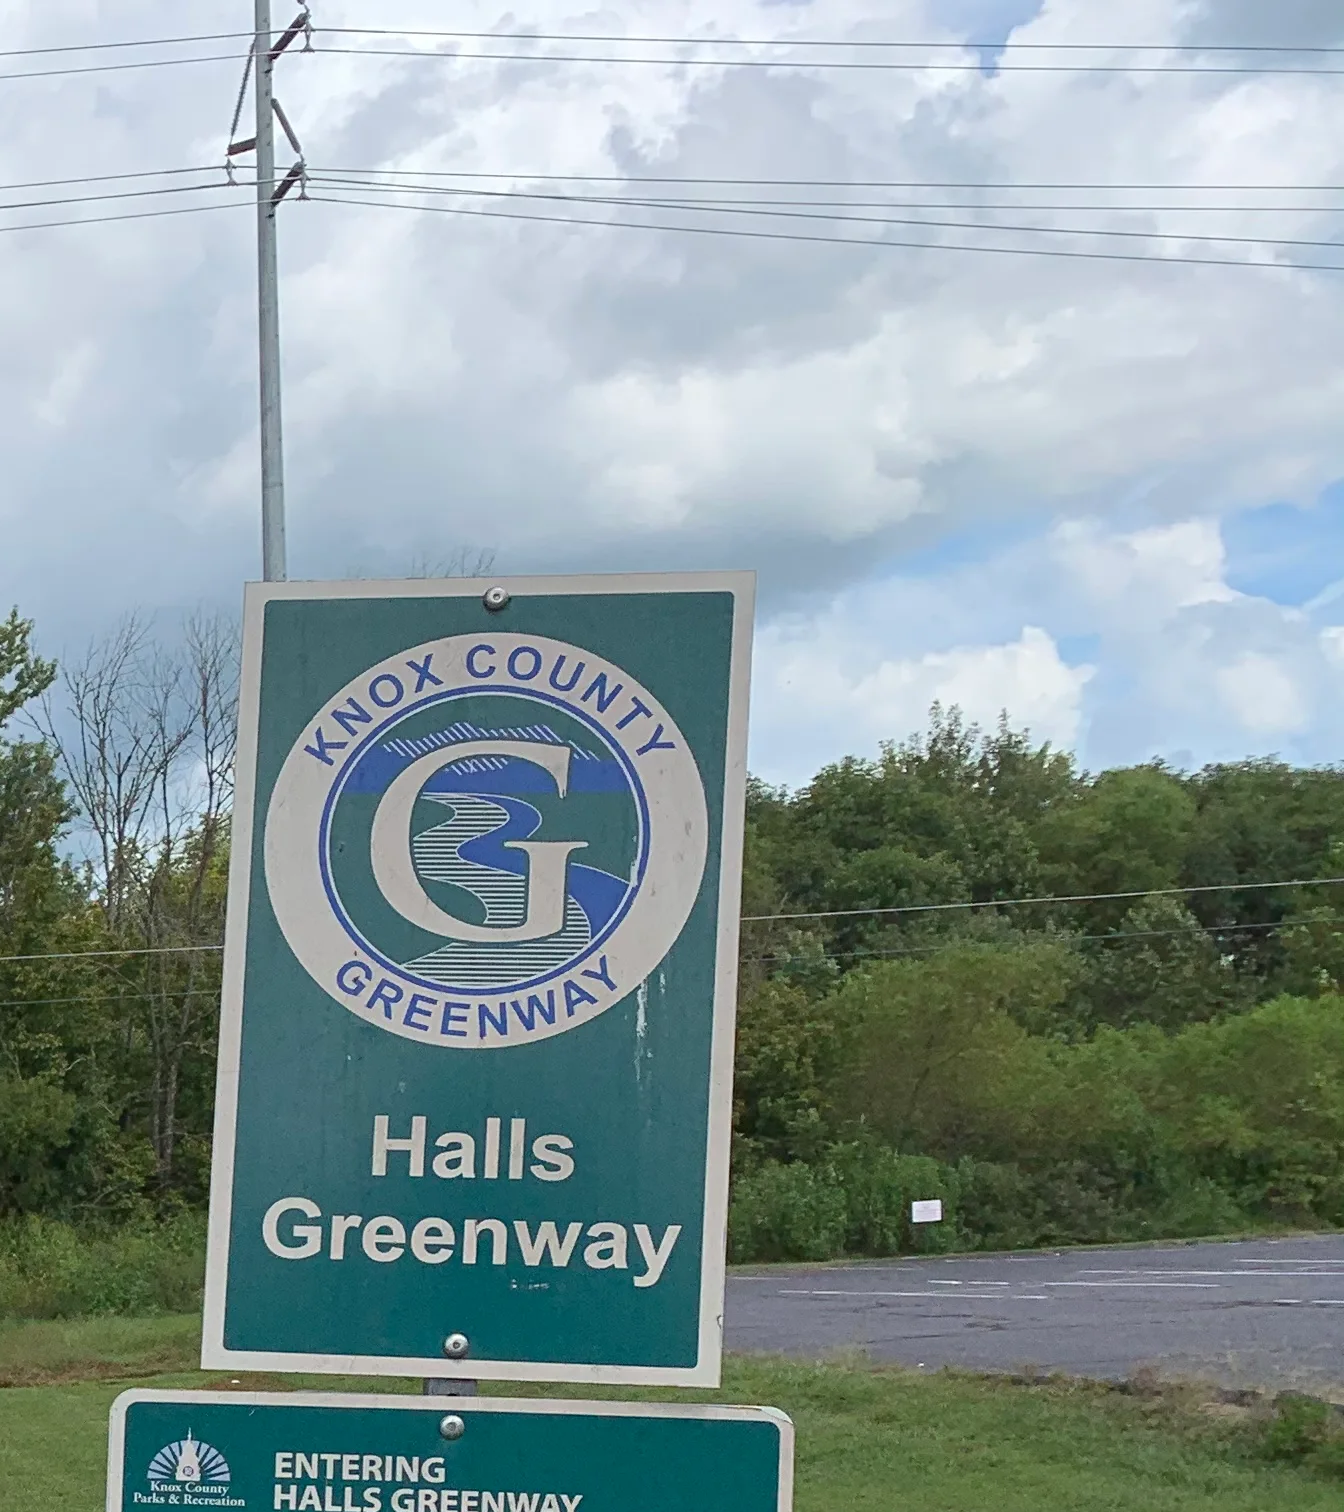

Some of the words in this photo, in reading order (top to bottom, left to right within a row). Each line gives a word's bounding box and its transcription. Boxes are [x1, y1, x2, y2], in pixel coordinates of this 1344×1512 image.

[303, 653, 441, 767] KNOX
[465, 644, 677, 758] COUNTY
[371, 739, 588, 943] G
[336, 953, 618, 1040] GREENWAY
[372, 1114, 575, 1181] Halls
[261, 1198, 682, 1289] Greenway
[133, 1493, 165, 1504] Parks
[168, 1494, 180, 1504] &
[183, 1494, 246, 1507] Recreation
[150, 1481, 182, 1493] Knox
[185, 1482, 229, 1496] County
[274, 1452, 446, 1484] ENTERING
